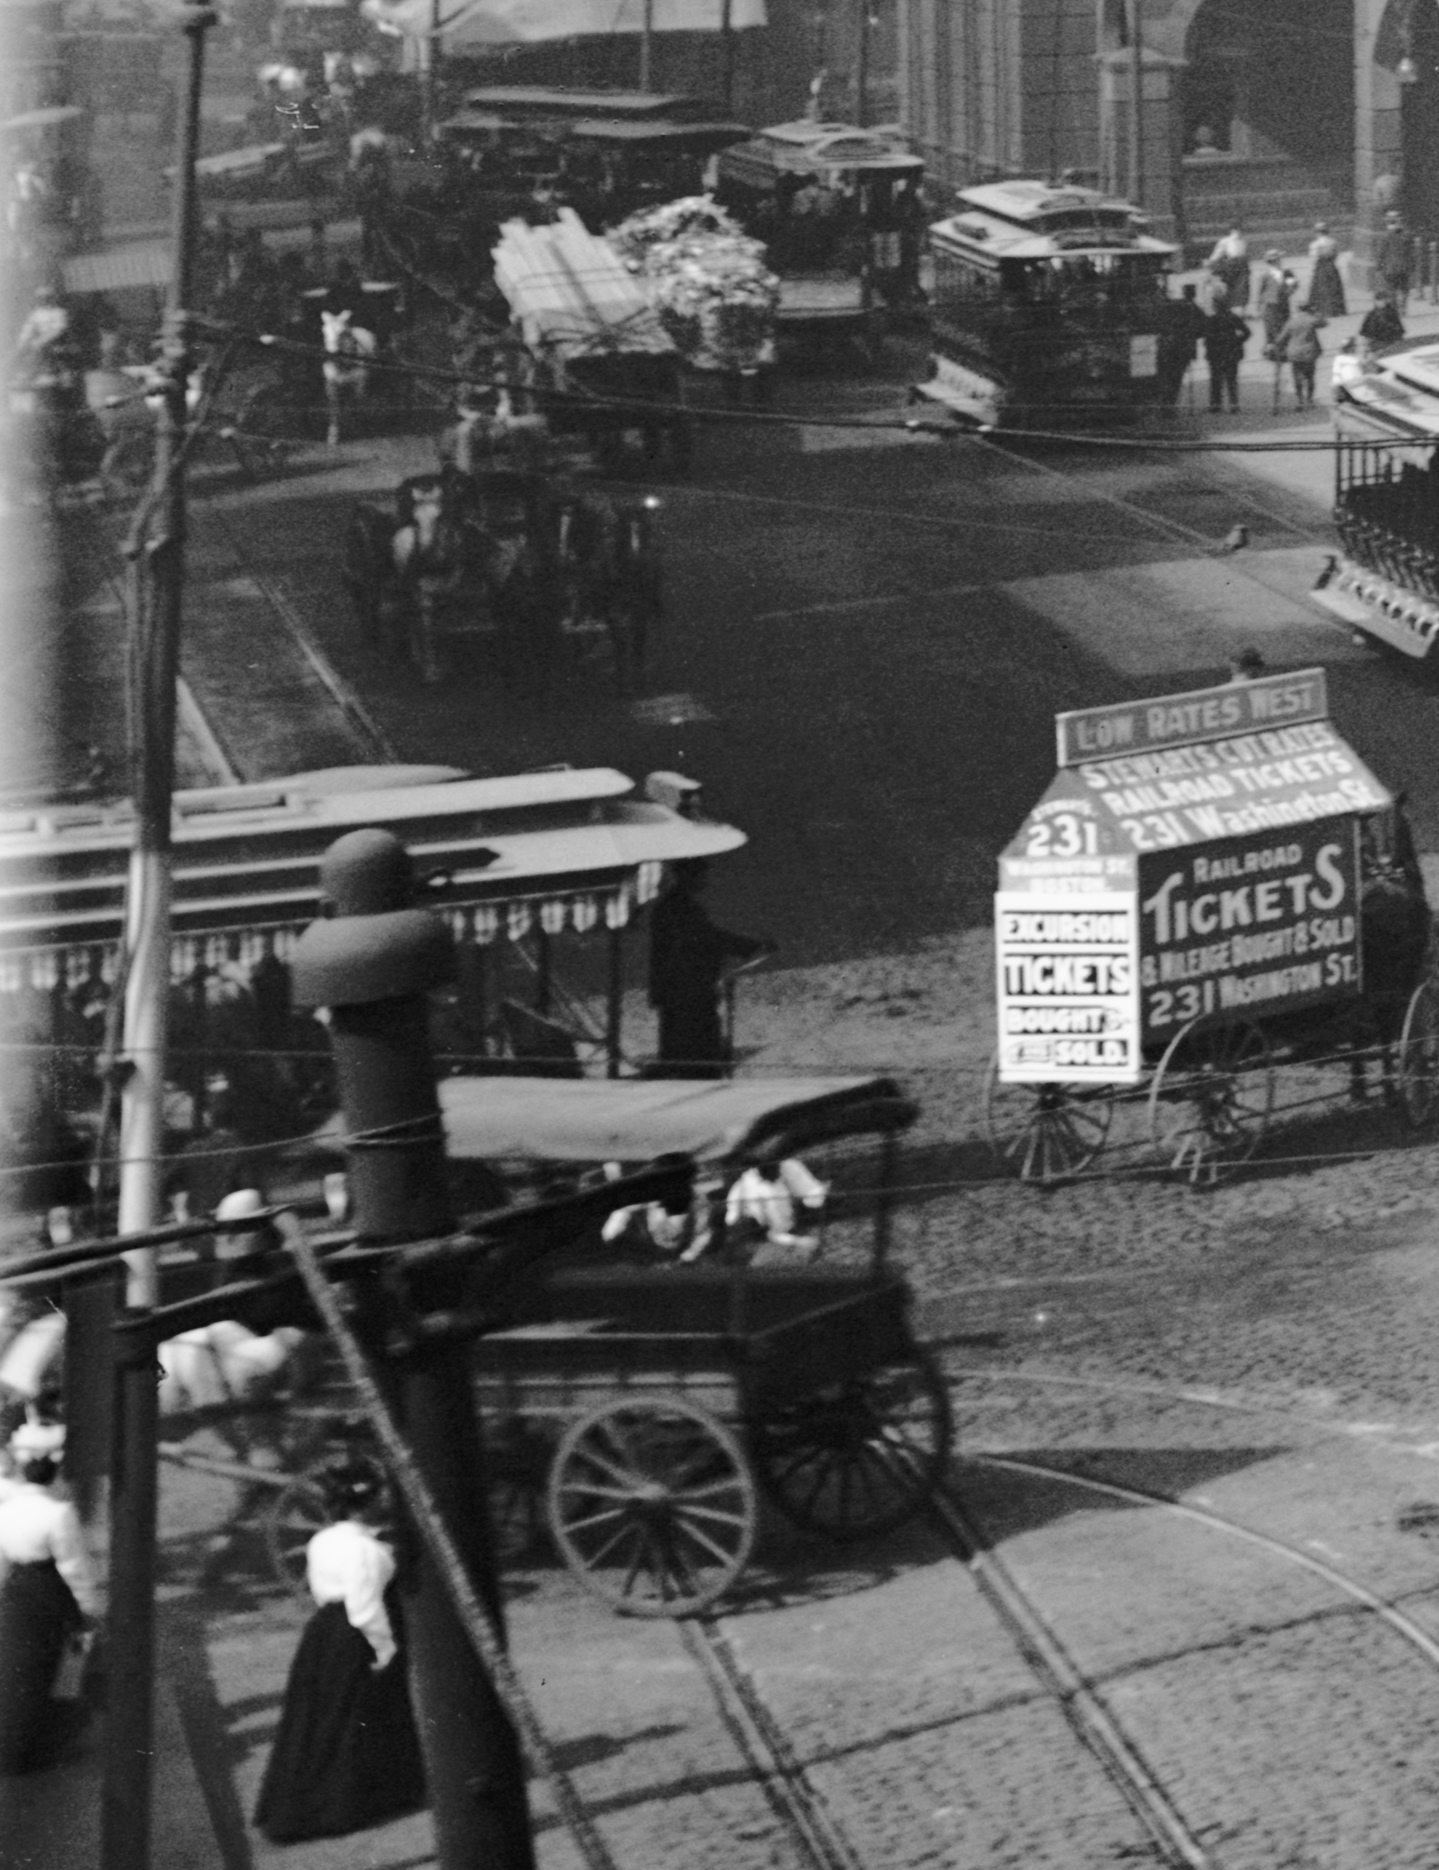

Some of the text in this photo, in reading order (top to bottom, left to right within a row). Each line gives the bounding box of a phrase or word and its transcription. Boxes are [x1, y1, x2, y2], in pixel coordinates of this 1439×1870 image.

[1076, 681, 1316, 750] LOW RATES WEST
[1260, 722, 1337, 757] RATES
[1101, 772, 1235, 815] RAILROAD
[1229, 750, 1354, 792] TICKETS
[1026, 813, 1098, 858] 231
[1119, 812, 1191, 850] 231
[1184, 789, 1354, 838] Washington
[1192, 843, 1303, 884] RAILROAD
[1143, 843, 1346, 944] TICKETS
[1007, 914, 1129, 941] EXCURSION
[1141, 915, 1355, 987] & MILEAGE BOUGHT & SOLD
[1005, 957, 1130, 993] TICKETS
[1148, 979, 1214, 1028] 231
[1218, 961, 1322, 1009] WASHINGTON
[1007, 1008, 1104, 1033] BOUGHT
